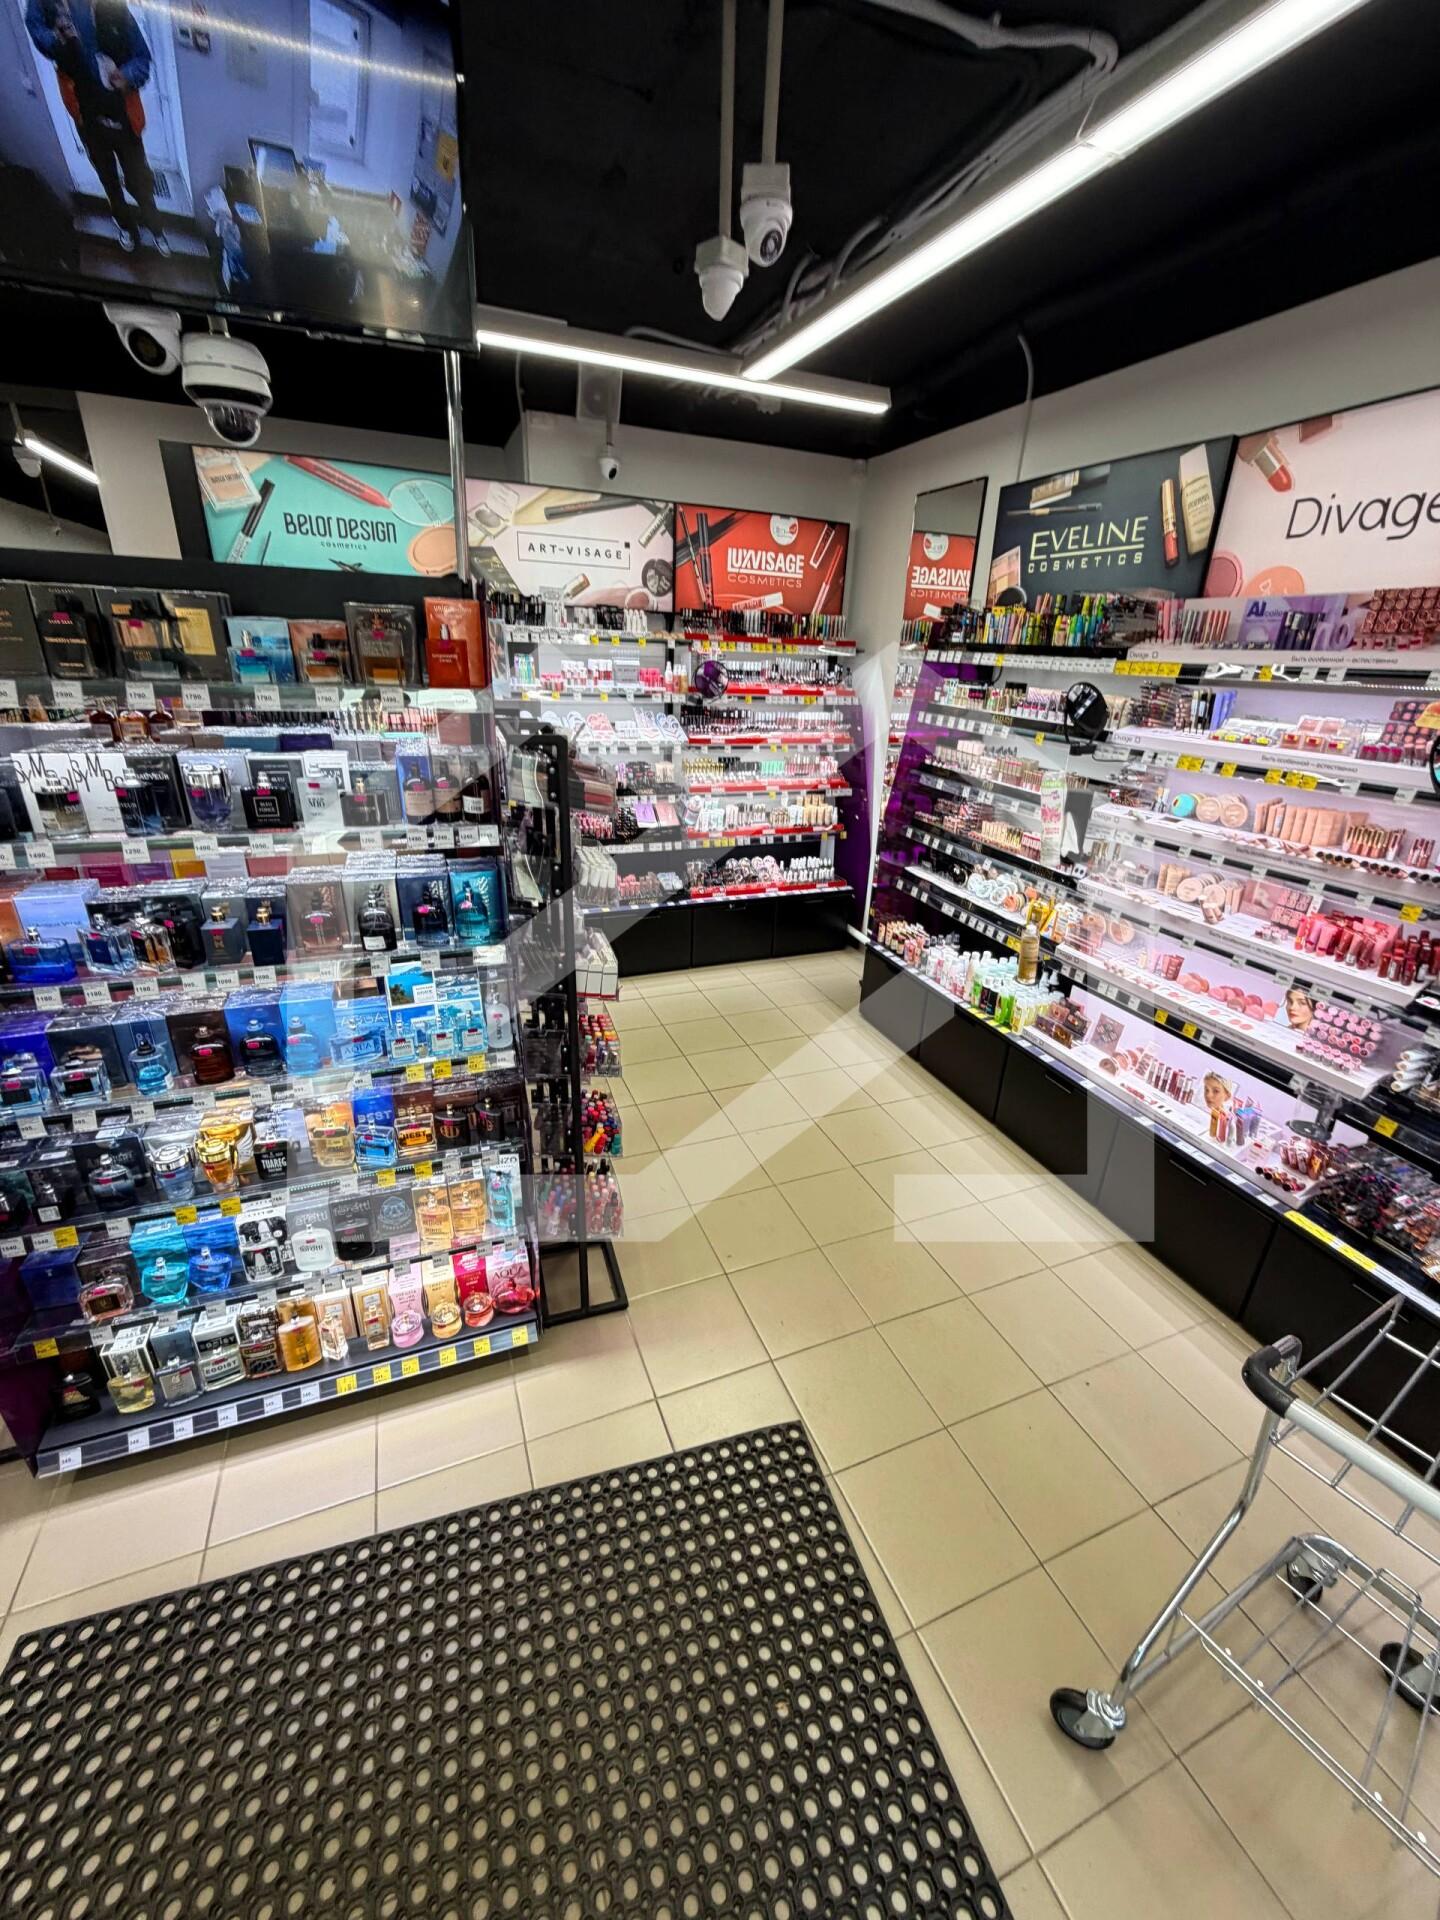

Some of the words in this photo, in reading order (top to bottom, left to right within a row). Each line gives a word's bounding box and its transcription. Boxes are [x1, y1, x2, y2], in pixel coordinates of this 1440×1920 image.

[1030, 516, 1149, 560] EVELINE
[528, 542, 622, 560] ART-VISAGE
[727, 547, 805, 578] LUXVISAGE
[1028, 552, 1143, 574] COSMETICS
[727, 574, 802, 588] COSMETICS
[261, 1156, 287, 1169] TUAREG
